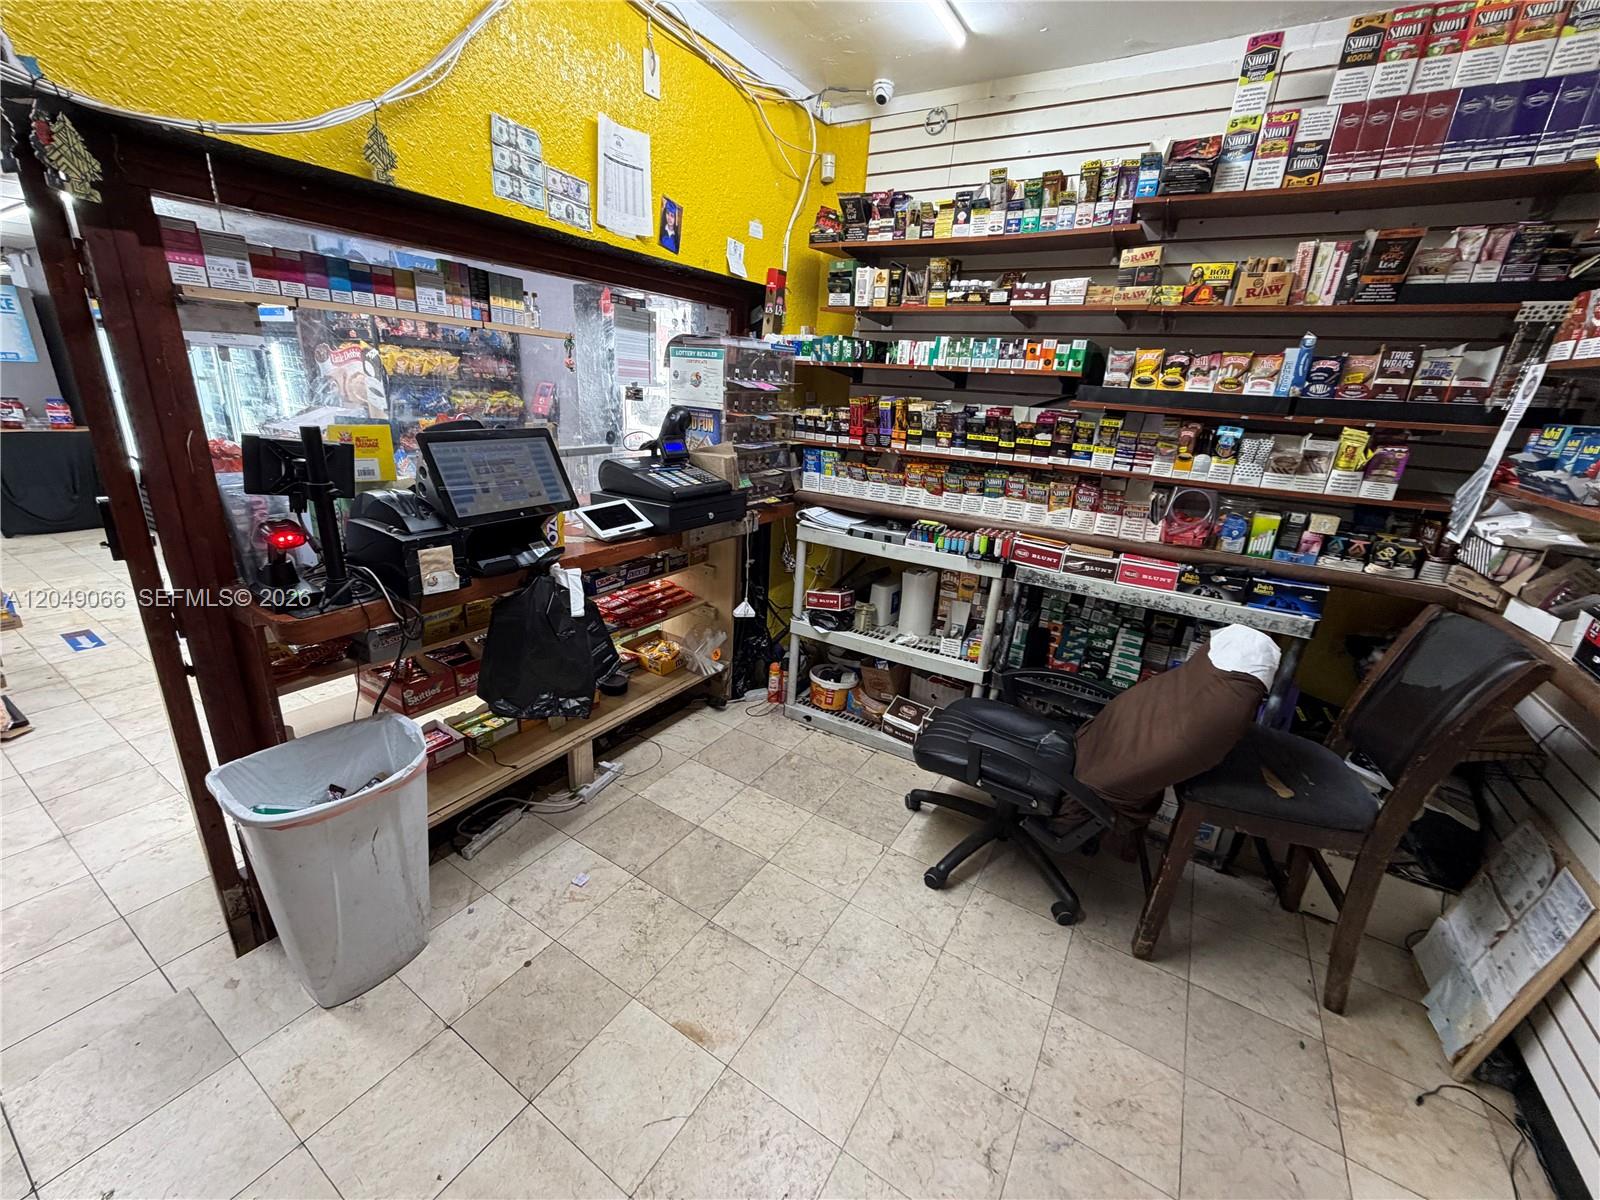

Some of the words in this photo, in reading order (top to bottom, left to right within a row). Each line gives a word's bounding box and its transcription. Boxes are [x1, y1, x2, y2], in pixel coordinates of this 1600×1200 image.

[1478, 7, 1515, 26] SHOW
[1388, 22, 1424, 39] SHOW
[1432, 16, 1467, 34] SHOW
[1348, 35, 1378, 50] SHOW
[1246, 55, 1274, 67] SHOW
[1262, 125, 1292, 138] SHOW
[1226, 135, 1253, 147] SHOW
[1130, 249, 1157, 263] RAW
[1209, 268, 1231, 276] BOB
[1122, 289, 1148, 301] RAW
[1245, 284, 1286, 299] RAW
[675, 349, 696, 357] LOTTERY
[697, 350, 718, 358] RETAILER
[1390, 351, 1414, 360] TRUE
[1382, 359, 1416, 369] WRAPS
[1431, 361, 1452, 369] TRUE
[1420, 368, 1453, 378] WRAPS
[1543, 426, 1565, 440] Advil
[1031, 553, 1059, 564] BLUNT
[1084, 564, 1113, 575] BLUNT
[1141, 574, 1174, 584] BLUNT
[1256, 582, 1274, 591] Dutch
[819, 597, 839, 605] BLUNT
[407, 687, 441, 707] Skittles
[894, 730, 914, 741] BLUNT
